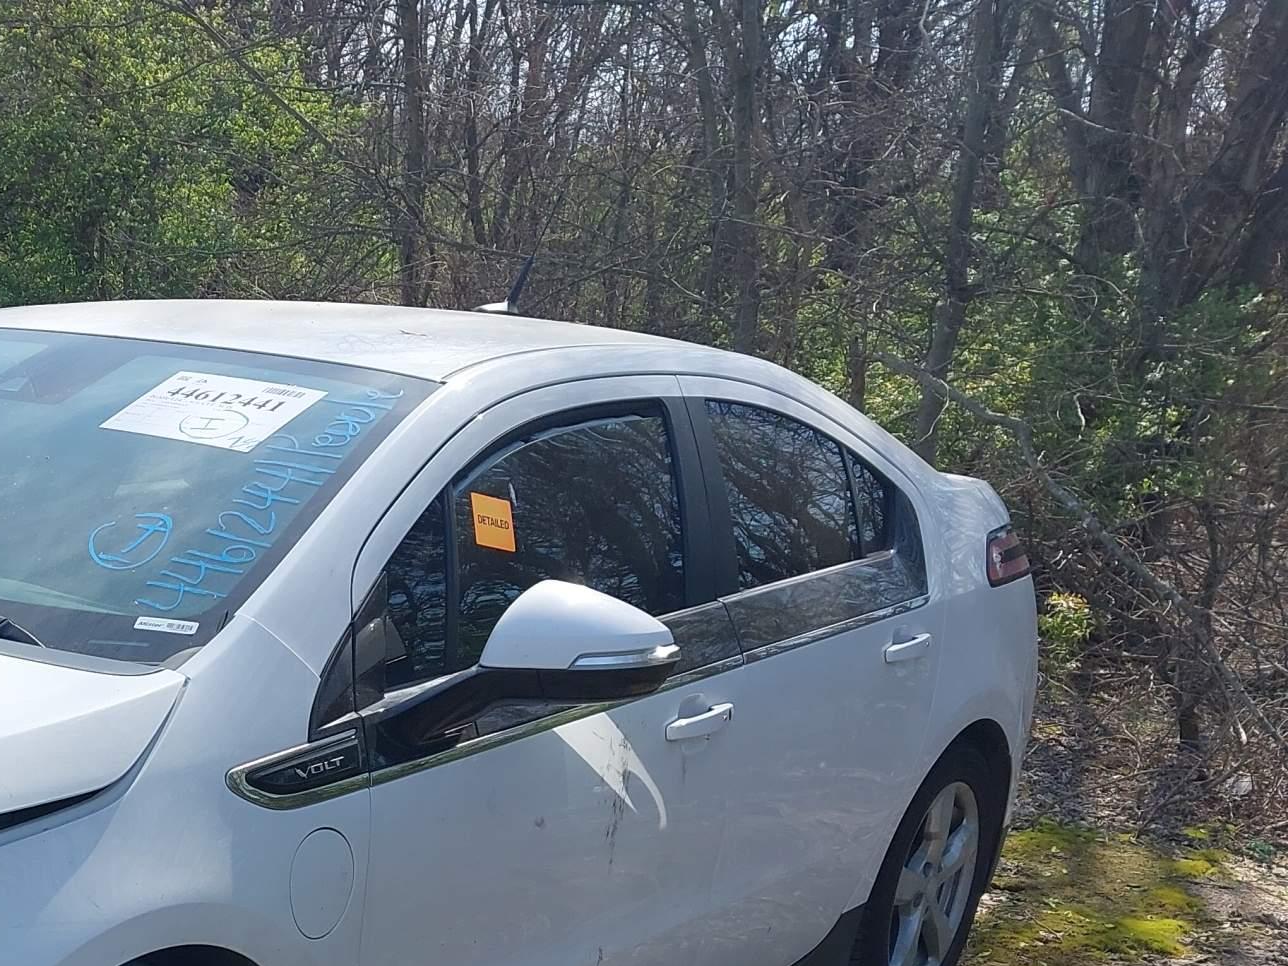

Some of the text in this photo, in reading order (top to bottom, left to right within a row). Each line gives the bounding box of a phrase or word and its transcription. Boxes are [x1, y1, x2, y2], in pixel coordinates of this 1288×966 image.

[167, 386, 286, 412] 44612441
[477, 514, 510, 530] DETAILED
[294, 756, 344, 779] VOLT
